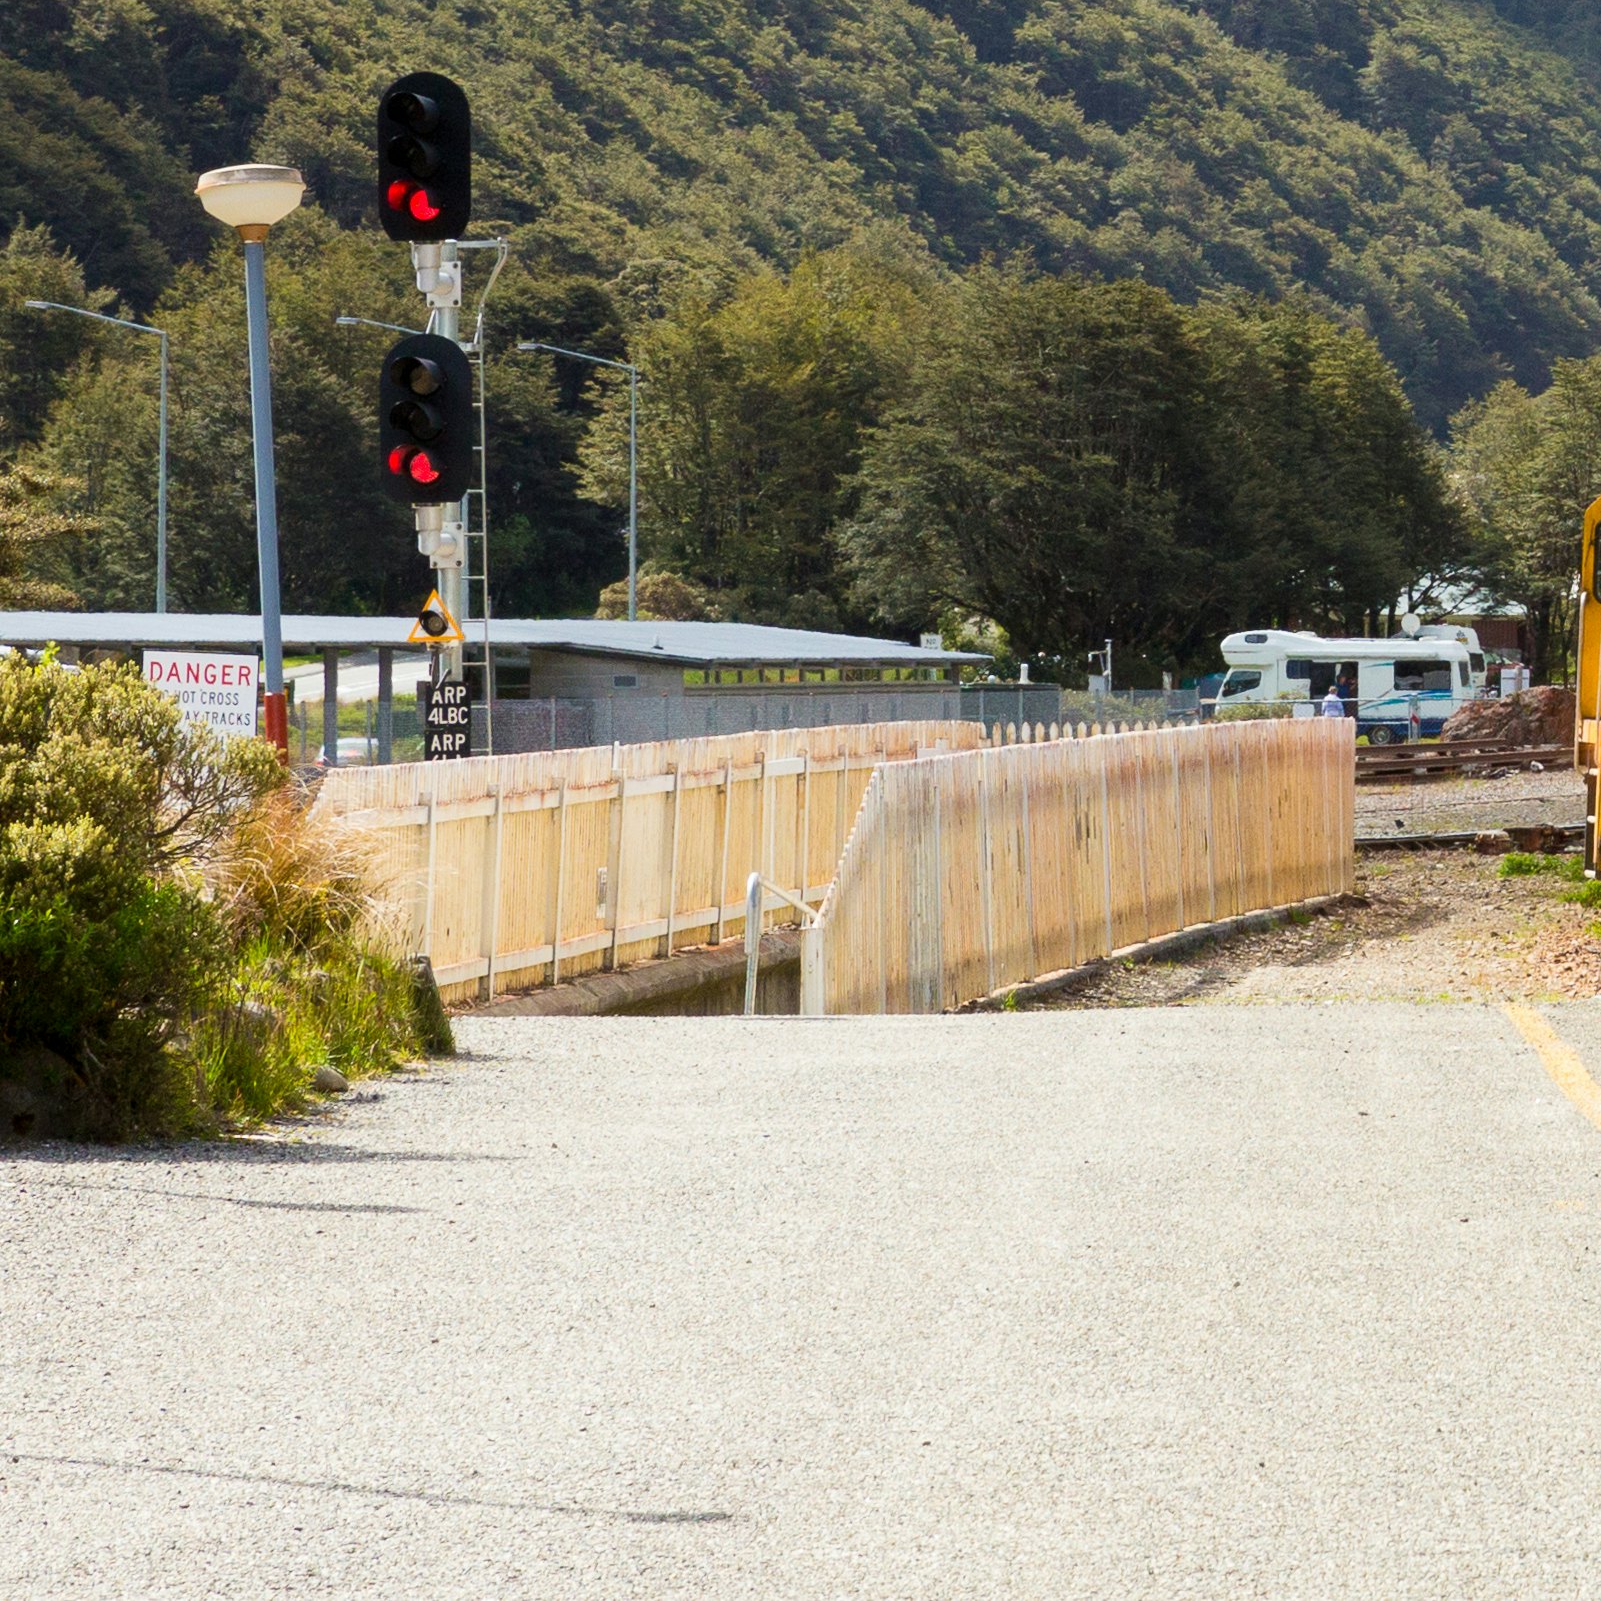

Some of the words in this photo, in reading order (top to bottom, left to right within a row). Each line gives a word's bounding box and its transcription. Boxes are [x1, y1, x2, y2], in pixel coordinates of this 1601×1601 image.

[149, 661, 252, 686] DANGER
[200, 691, 240, 706] CROSS
[431, 686, 467, 704] ARP
[205, 711, 251, 726] TRACKS
[427, 706, 468, 725] 4LBC
[430, 733, 466, 752] ARP
